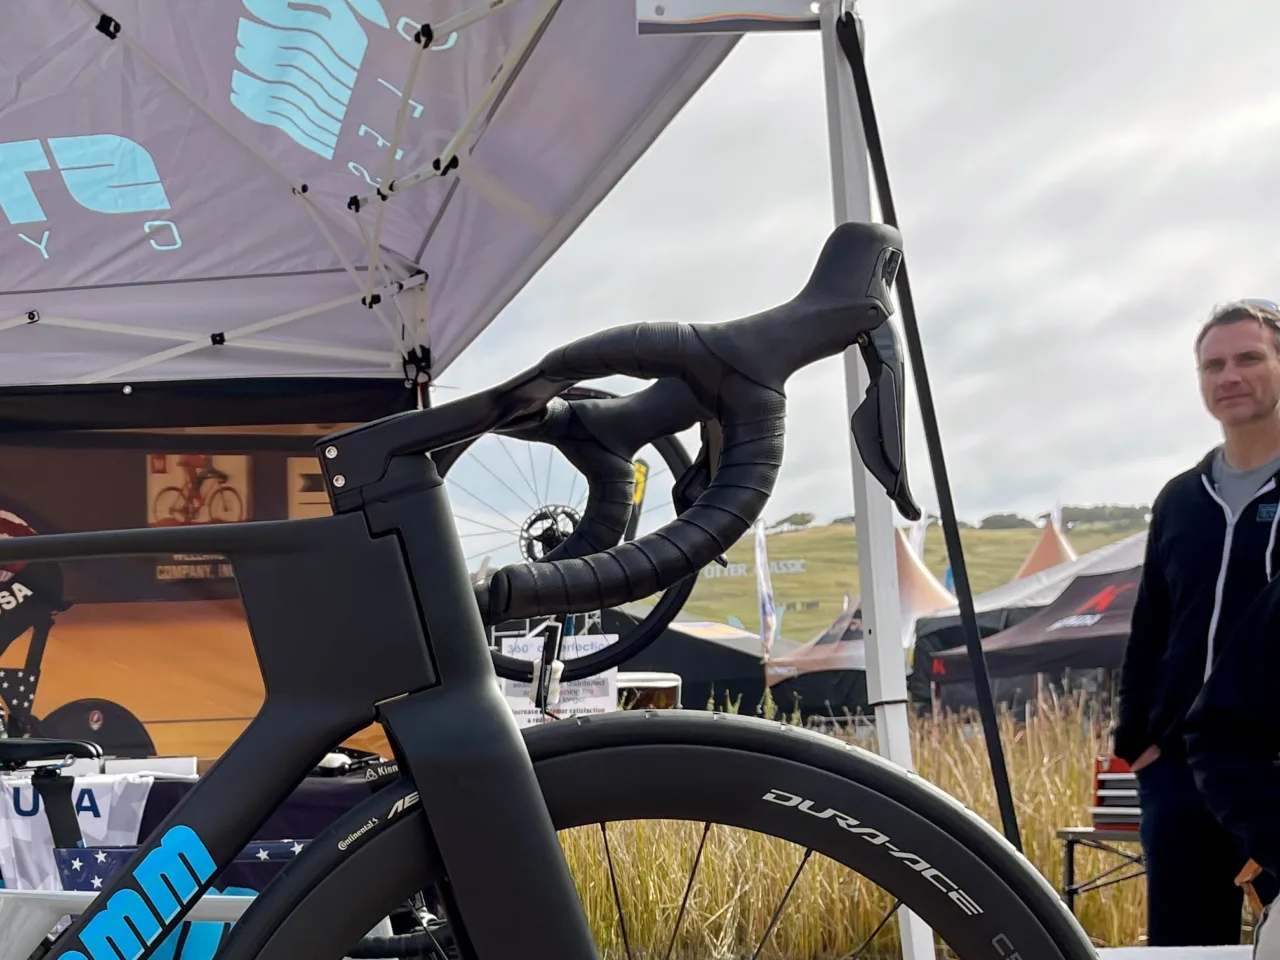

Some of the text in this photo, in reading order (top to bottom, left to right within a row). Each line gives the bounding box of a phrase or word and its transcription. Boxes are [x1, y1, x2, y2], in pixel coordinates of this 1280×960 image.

[13, 787, 102, 818] UA
[337, 819, 375, 851] Continental
[762, 789, 984, 916] DURA-ACE
